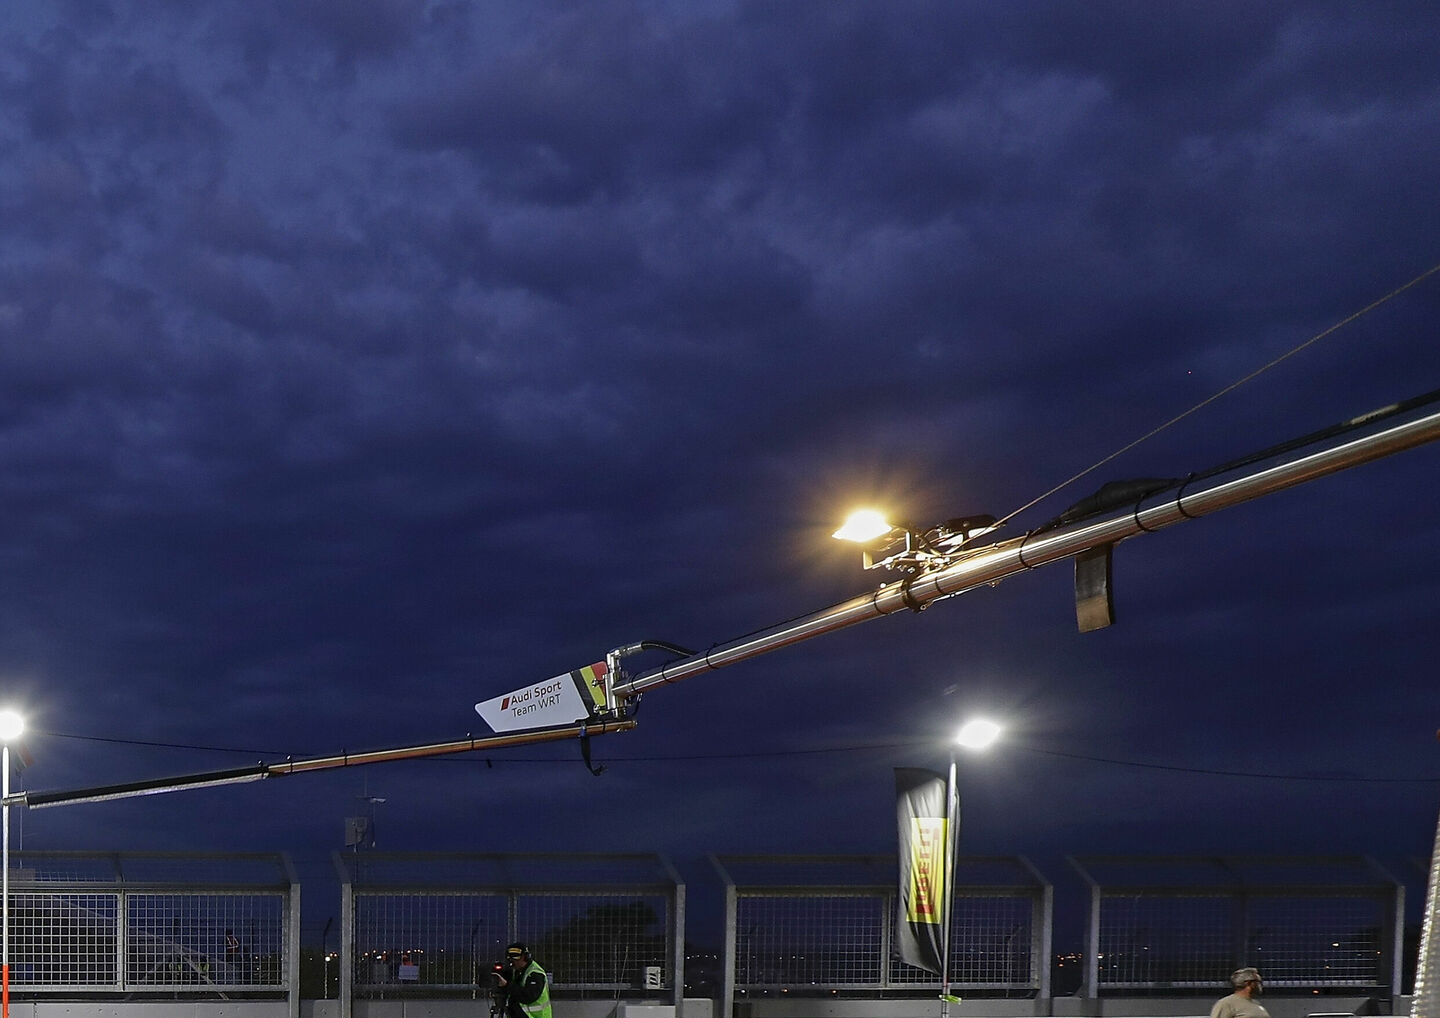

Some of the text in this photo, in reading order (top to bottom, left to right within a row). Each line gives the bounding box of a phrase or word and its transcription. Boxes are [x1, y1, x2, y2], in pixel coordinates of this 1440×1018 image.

[511, 681, 562, 705] Audi Sport
[512, 694, 561, 717] Team WRT
